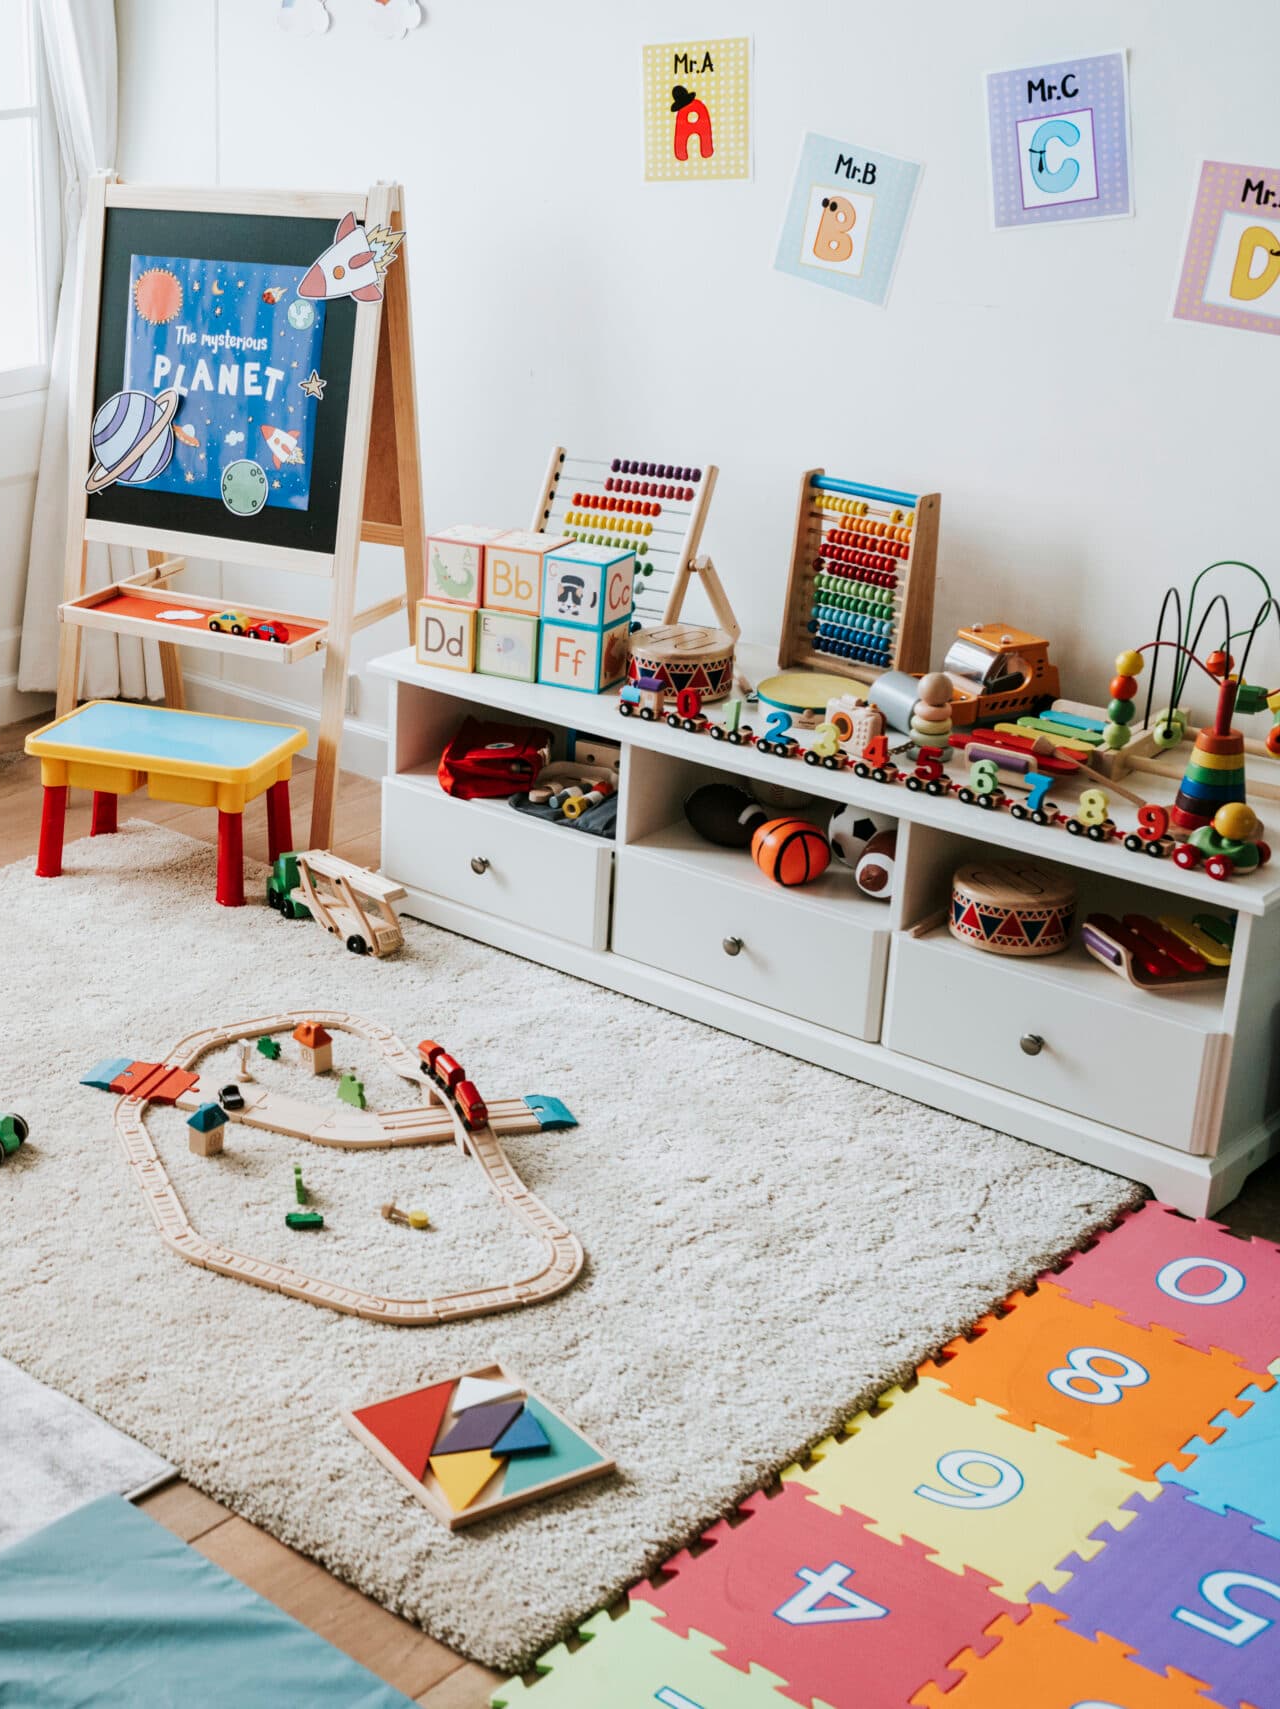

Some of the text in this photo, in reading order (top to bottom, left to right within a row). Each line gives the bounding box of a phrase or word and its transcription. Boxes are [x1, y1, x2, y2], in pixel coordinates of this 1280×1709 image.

[674, 51, 714, 75] Mr.A
[1027, 73, 1080, 104] Mr.C
[834, 153, 878, 185] Mr.B
[1241, 178, 1280, 208] Mr.
[175, 326, 268, 354] The mysterious
[153, 354, 286, 402] PLANET
[492, 559, 533, 601] Bb
[609, 572, 630, 610] Cc
[425, 616, 464, 658] Dd
[555, 636, 588, 676] Ff
[677, 687, 701, 718] 0
[724, 699, 741, 730] 1
[766, 711, 792, 744] 2
[815, 722, 840, 757] 3
[863, 736, 889, 768] 4
[915, 747, 942, 781] 5
[969, 760, 998, 795] 6
[1025, 773, 1053, 811] 7
[1079, 790, 1108, 827] 8
[1137, 805, 1169, 841] 9
[1047, 1346, 1151, 1405] 8
[772, 1560, 891, 1626] 4
[1172, 1571, 1280, 1647] 5
